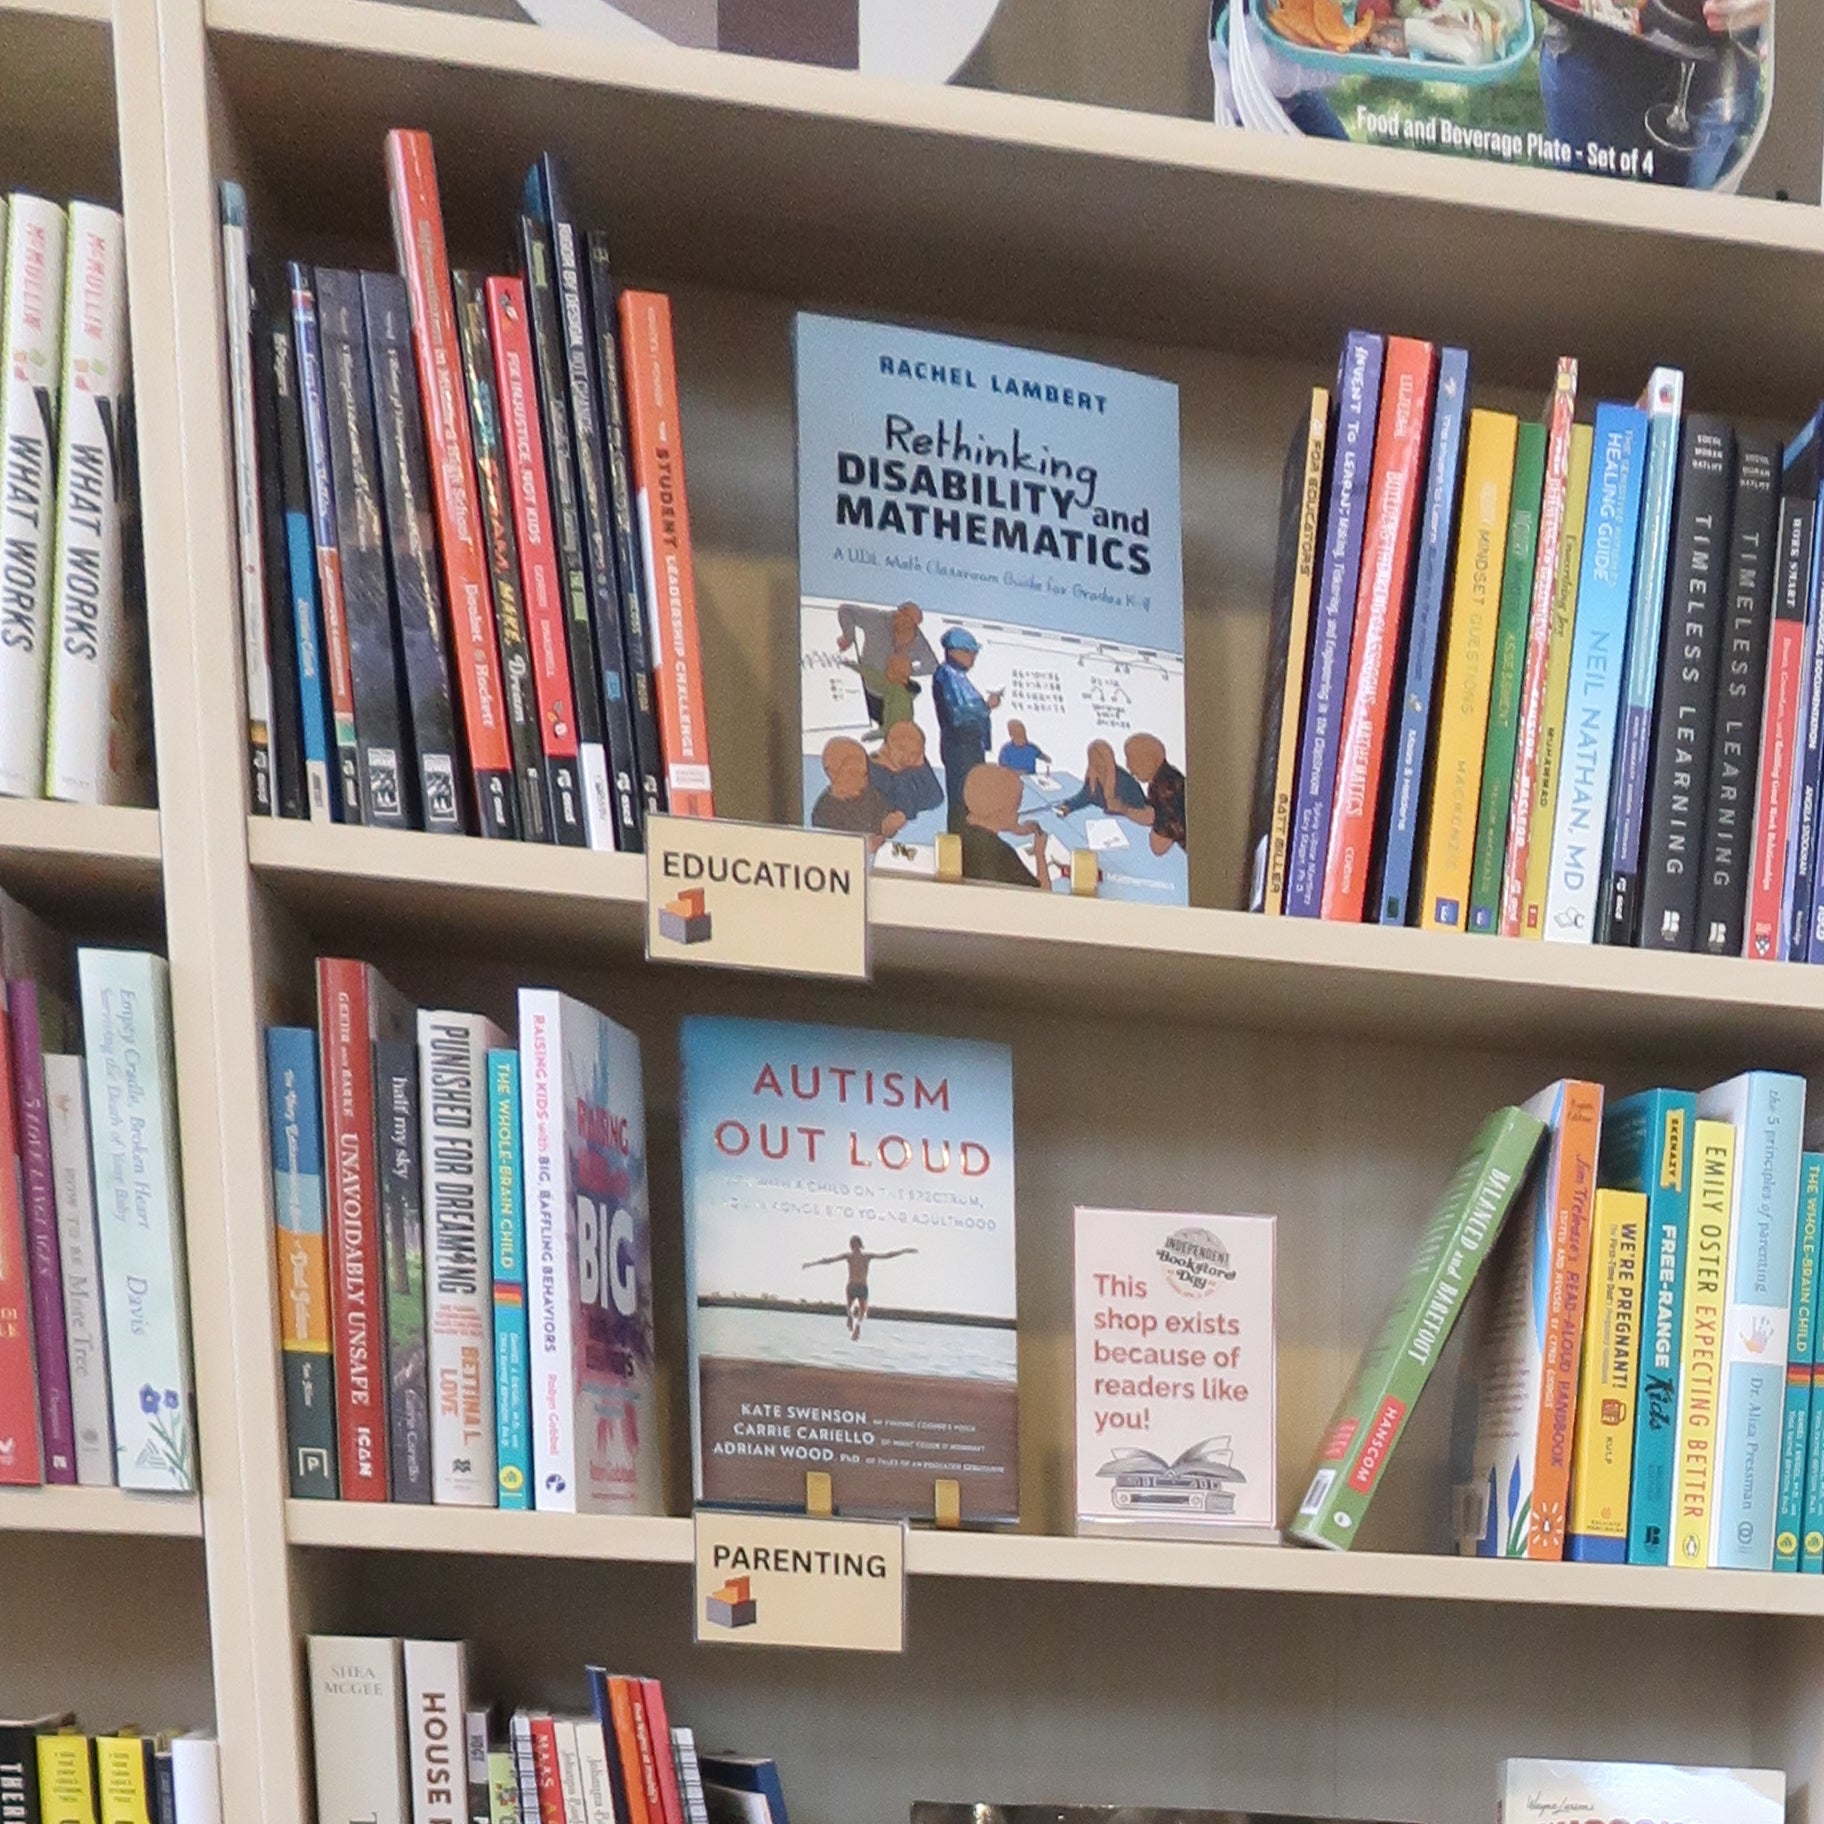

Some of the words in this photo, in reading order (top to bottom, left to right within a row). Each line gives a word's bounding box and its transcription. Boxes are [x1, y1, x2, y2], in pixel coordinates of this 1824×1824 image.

[1357, 105, 1399, 134] Food
[1403, 113, 1436, 141] and
[1440, 117, 1521, 158] Beverage
[1527, 131, 1571, 162] Plate
[1587, 139, 1618, 168] Set
[1621, 144, 1638, 172] of
[1641, 149, 1654, 175] 4
[879, 355, 976, 390] RACHEL
[991, 375, 1108, 414] LAMBERT
[70, 442, 102, 526] WHAT
[837, 451, 1075, 520] DISABILITY
[1092, 500, 1150, 537] and
[885, 414, 1098, 509] Rethinking
[1598, 432, 1622, 517] HEALING
[653, 448, 680, 549] STUDENT
[835, 495, 1153, 576] MATHEMATICS
[1592, 521, 1616, 582] GUIDE
[64, 545, 100, 661] WORKS
[664, 555, 688, 657] LEADERSHIP
[1681, 514, 1713, 683] TIMELESS
[1584, 628, 1609, 693] NEIL
[675, 661, 696, 758] CHALLENGE
[1567, 708, 1601, 834] NATHAN,
[1665, 705, 1698, 876] LEARNING
[662, 851, 851, 895] EDUCATION
[1563, 844, 1588, 891] MD
[430, 1025, 473, 1127] PUNISHED
[752, 1062, 950, 1111] AUTISM
[433, 1136, 473, 1176] FOR
[714, 1120, 826, 1159] OUT
[850, 1132, 990, 1176] LOUD
[1701, 1147, 1727, 1211] EMILY
[339, 1133, 365, 1305] UNAVOIDABLY
[1460, 1168, 1512, 1251] BALANCED
[1093, 1272, 1147, 1299] This
[1156, 1248, 1237, 1281] Bookstore
[1164, 1237, 1230, 1264] INDEPENDENT
[1176, 1268, 1208, 1290] Day
[1447, 1251, 1466, 1276] and
[1618, 1223, 1638, 1280] WE'RE
[1698, 1224, 1721, 1294] OSTER
[1094, 1306, 1158, 1337] shop
[1165, 1313, 1240, 1336] exists
[1407, 1280, 1459, 1366] BAREFOOT
[1655, 1225, 1677, 1368] FREE-RANGE
[348, 1311, 369, 1405] UNSAFE
[1094, 1340, 1206, 1367] because
[1214, 1346, 1241, 1367] of
[1612, 1286, 1634, 1389] PREGNANT!
[1688, 1305, 1716, 1427] EXPECTING
[740, 1403, 782, 1419] KATE
[787, 1406, 866, 1425] SWENSON
[1094, 1373, 1195, 1400] readers
[1203, 1379, 1248, 1400] like
[1095, 1408, 1150, 1433] you!
[1645, 1373, 1674, 1429] Kids
[714, 1442, 776, 1459] ADRIAN
[781, 1446, 832, 1461] WOOD
[733, 1423, 792, 1439] CARRIE
[797, 1427, 875, 1445] CARIELLO
[1356, 1405, 1398, 1483] HANSCOM
[1683, 1440, 1709, 1517] BETTER
[713, 1545, 887, 1579] PARENTING
[422, 1692, 451, 1805] HOUSE
